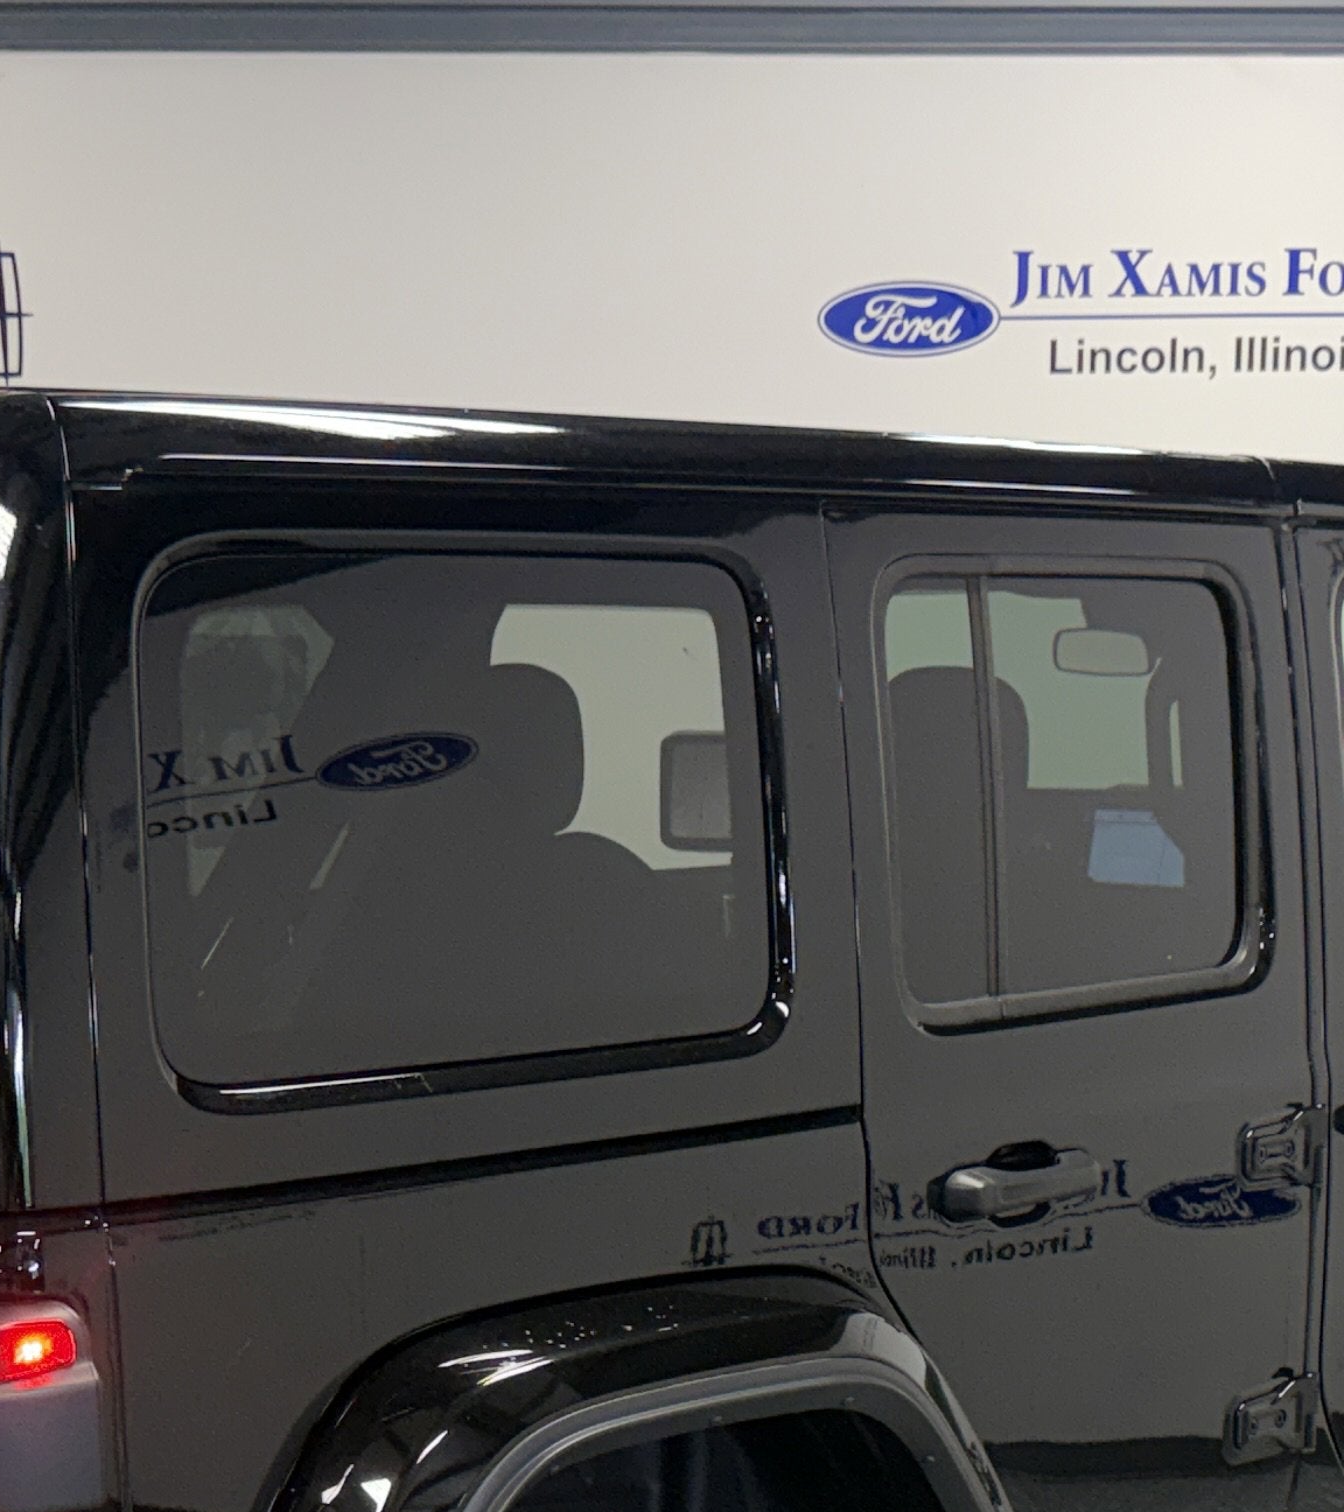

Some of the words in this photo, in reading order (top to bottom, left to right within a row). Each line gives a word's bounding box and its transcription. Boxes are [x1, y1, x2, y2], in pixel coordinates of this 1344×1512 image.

[1010, 250, 1094, 307] JIM
[1108, 248, 1267, 298] XAMIS
[853, 294, 964, 345] Ford
[1049, 337, 1217, 379] Lincoln,
